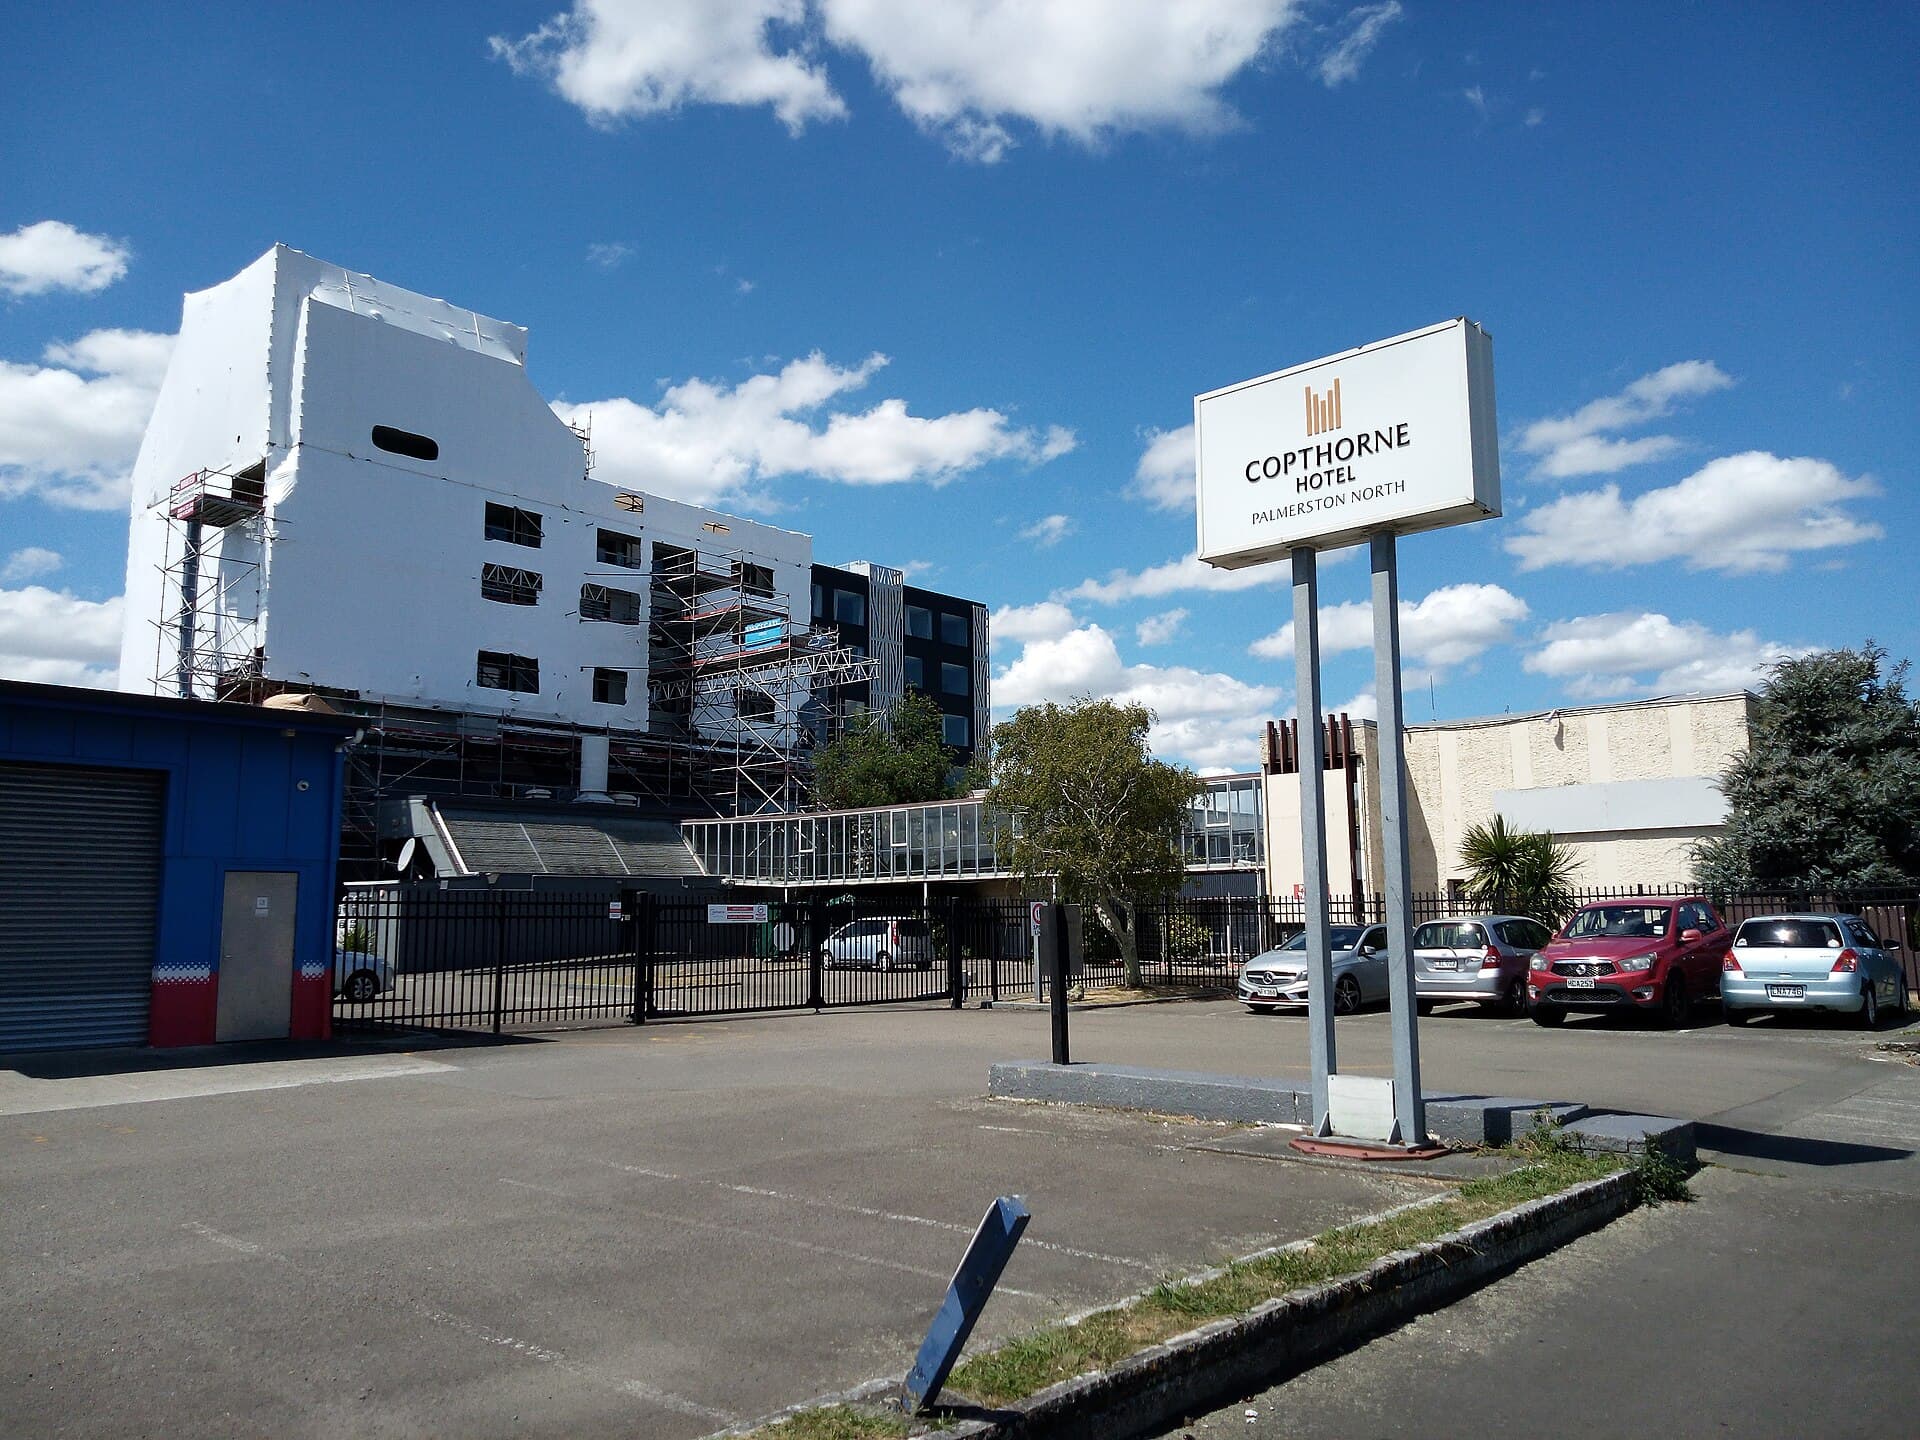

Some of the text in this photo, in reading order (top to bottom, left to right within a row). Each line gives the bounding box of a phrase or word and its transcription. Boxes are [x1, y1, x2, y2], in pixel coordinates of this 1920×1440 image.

[1245, 422, 1411, 483] COPTHORNE
[1296, 465, 1356, 494] HOTEL
[1252, 480, 1406, 525] PALMERSTON NORTH
